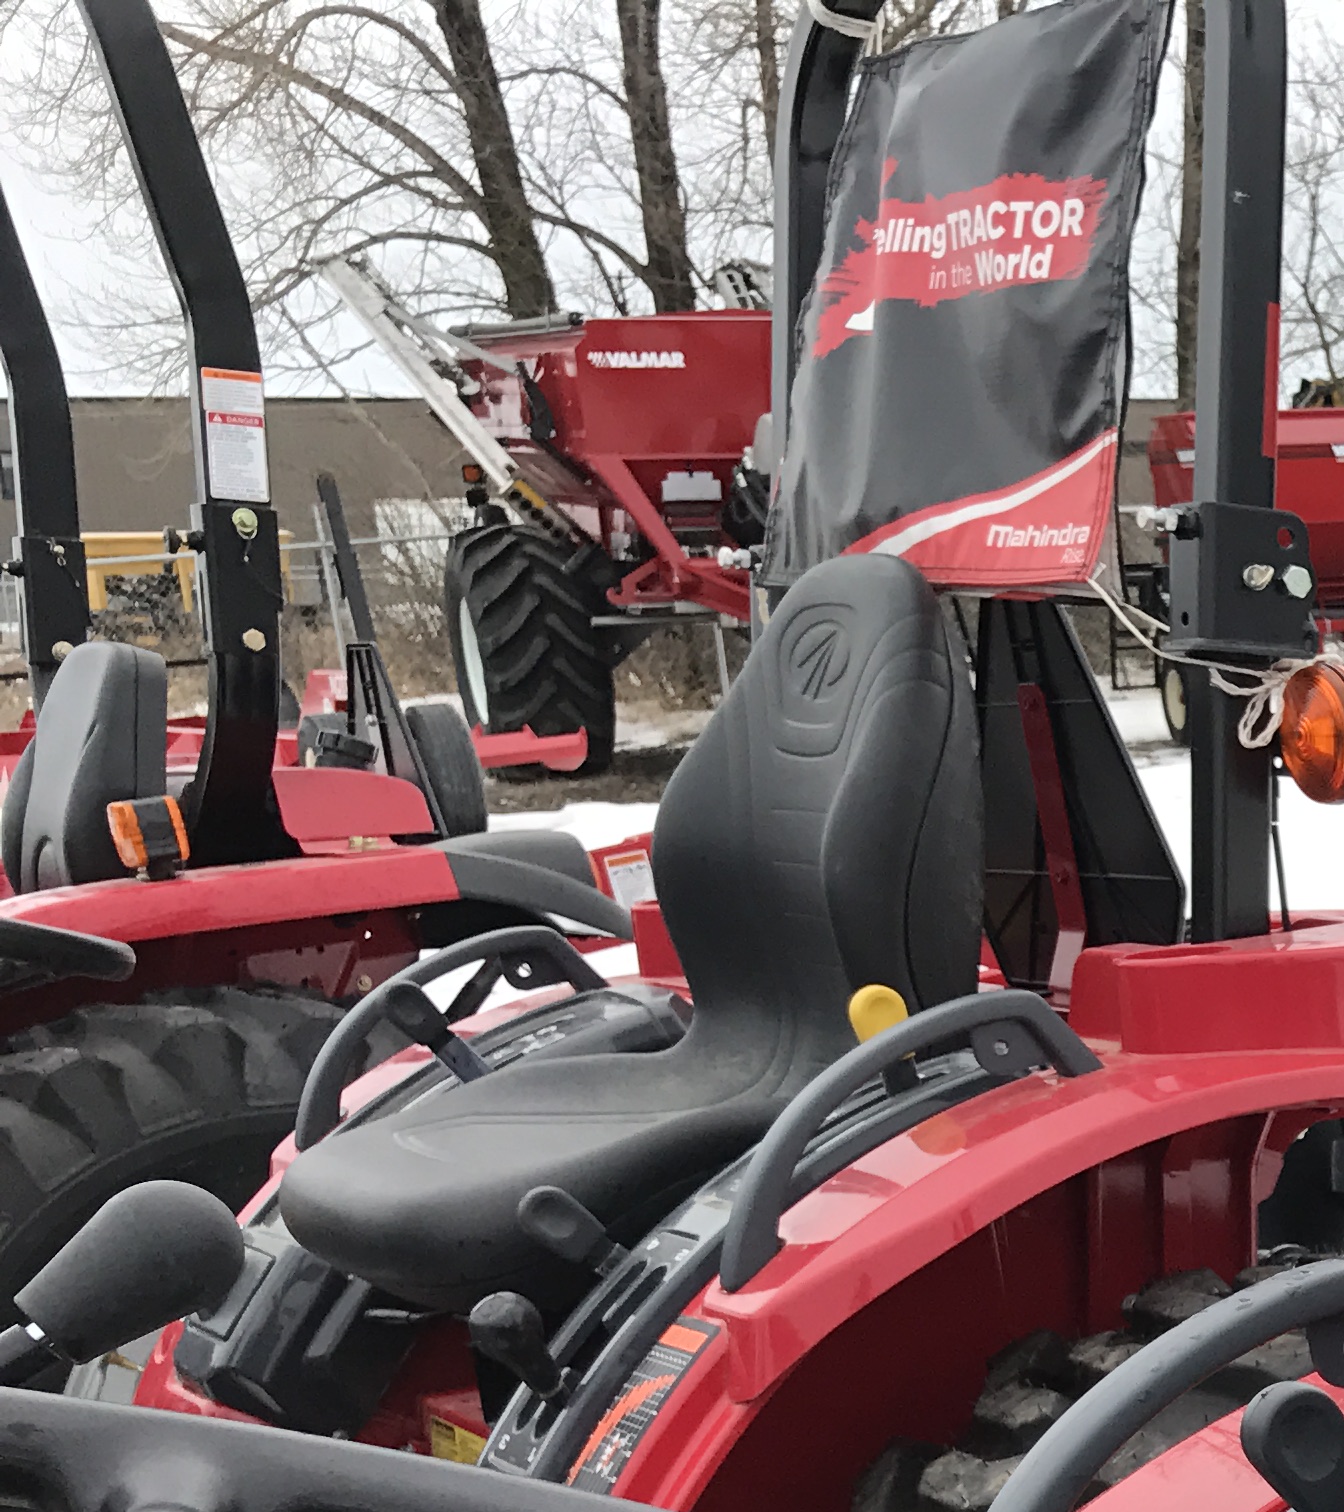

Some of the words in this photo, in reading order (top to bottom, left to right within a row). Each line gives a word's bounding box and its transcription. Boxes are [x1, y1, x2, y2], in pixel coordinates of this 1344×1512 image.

[947, 199, 1085, 251] TRACTOR
[929, 265, 947, 289] in
[951, 261, 973, 288] the
[974, 244, 1054, 286] World
[604, 350, 687, 369] VALMAR
[986, 522, 1091, 548] Mahindra
